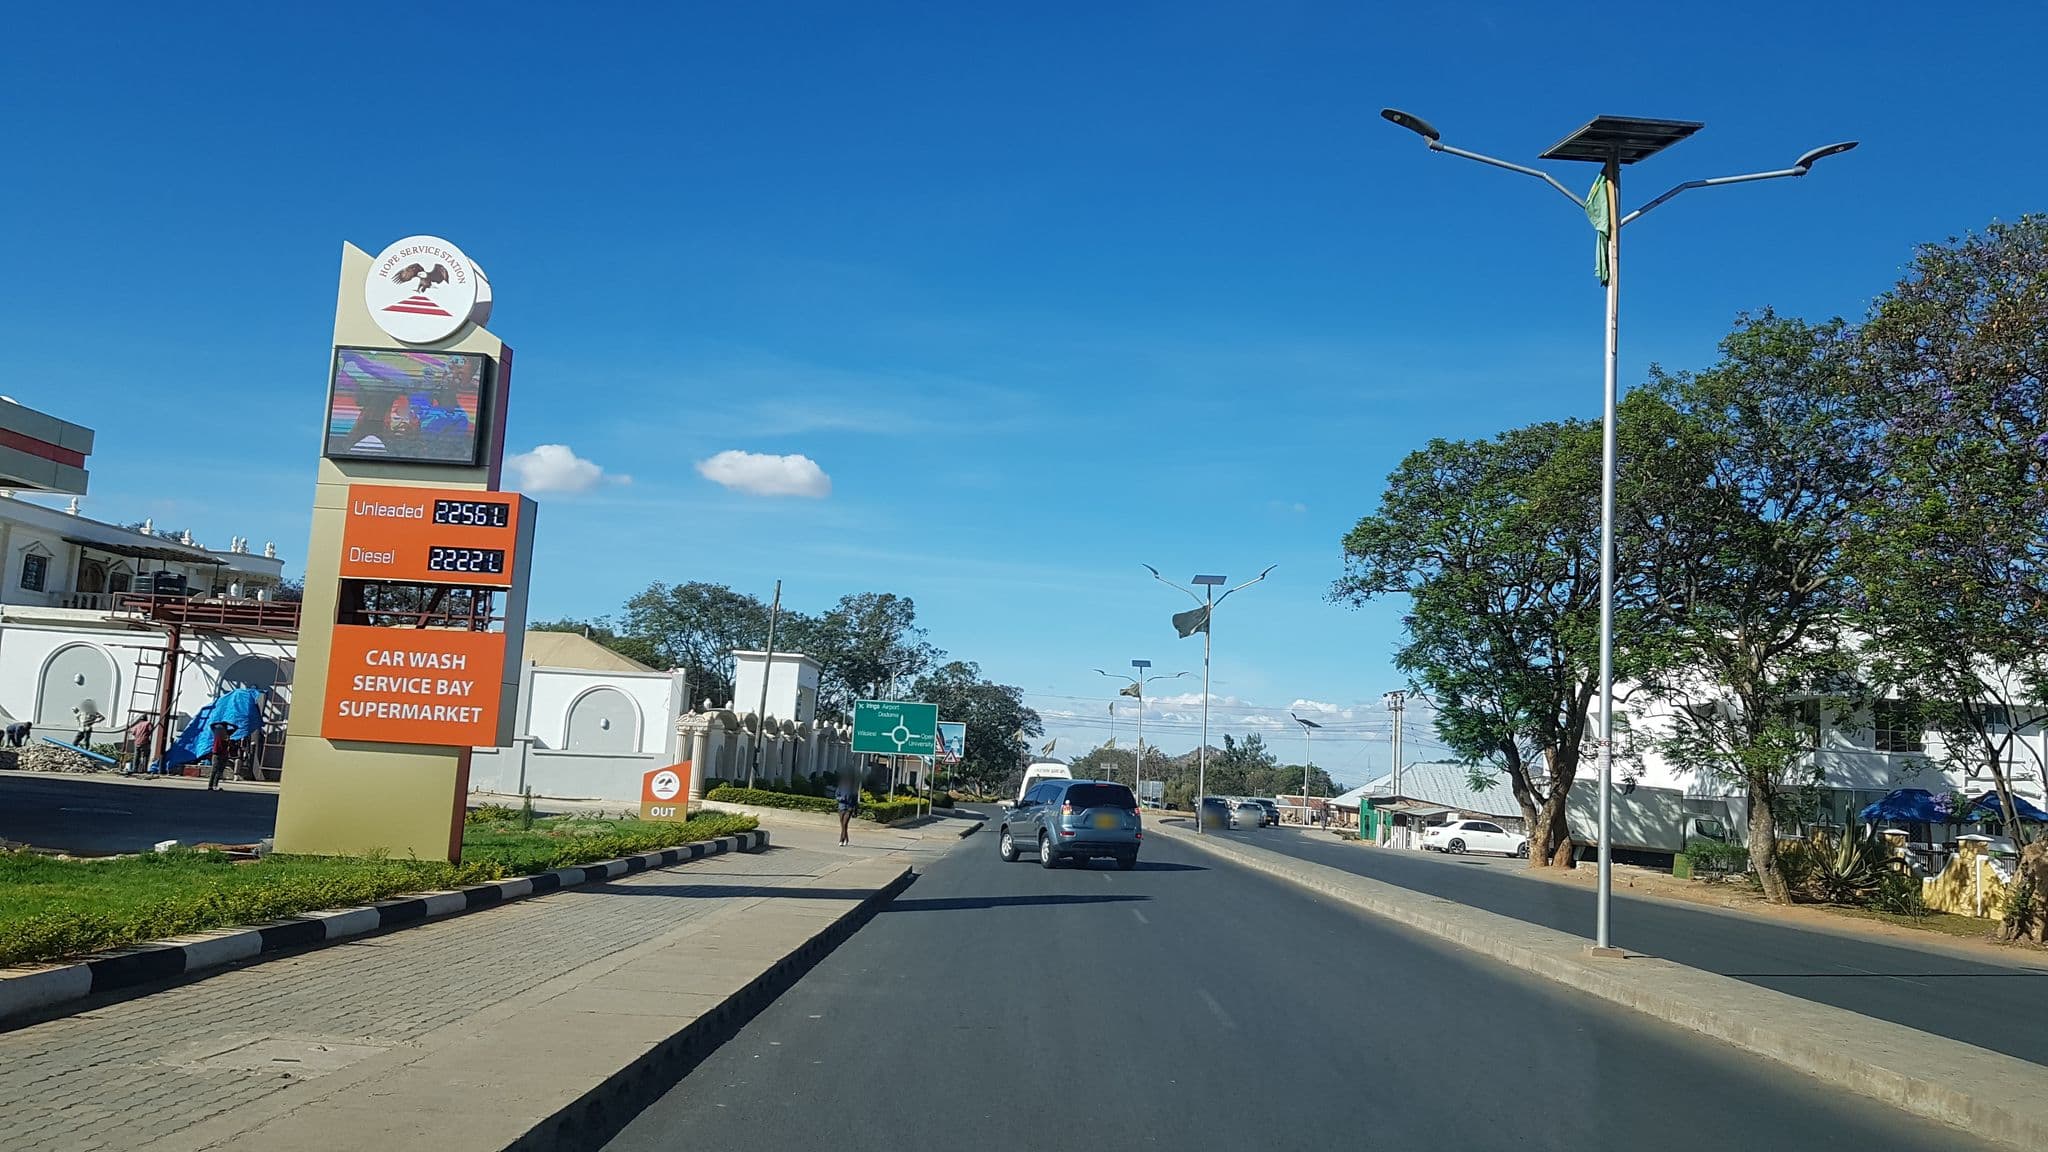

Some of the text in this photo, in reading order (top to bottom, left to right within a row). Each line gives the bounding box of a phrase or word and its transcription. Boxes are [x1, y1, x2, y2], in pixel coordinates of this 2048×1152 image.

[379, 246, 466, 284] HOPE SERVICE STATION
[354, 501, 424, 519] Unleaded
[349, 547, 395, 564] Diesel
[365, 650, 467, 670] CAR WASH
[352, 675, 474, 697] SERVICE BAY
[338, 700, 483, 723] SUPERMARKET
[908, 740, 933, 748] University
[651, 806, 676, 817] OUT
